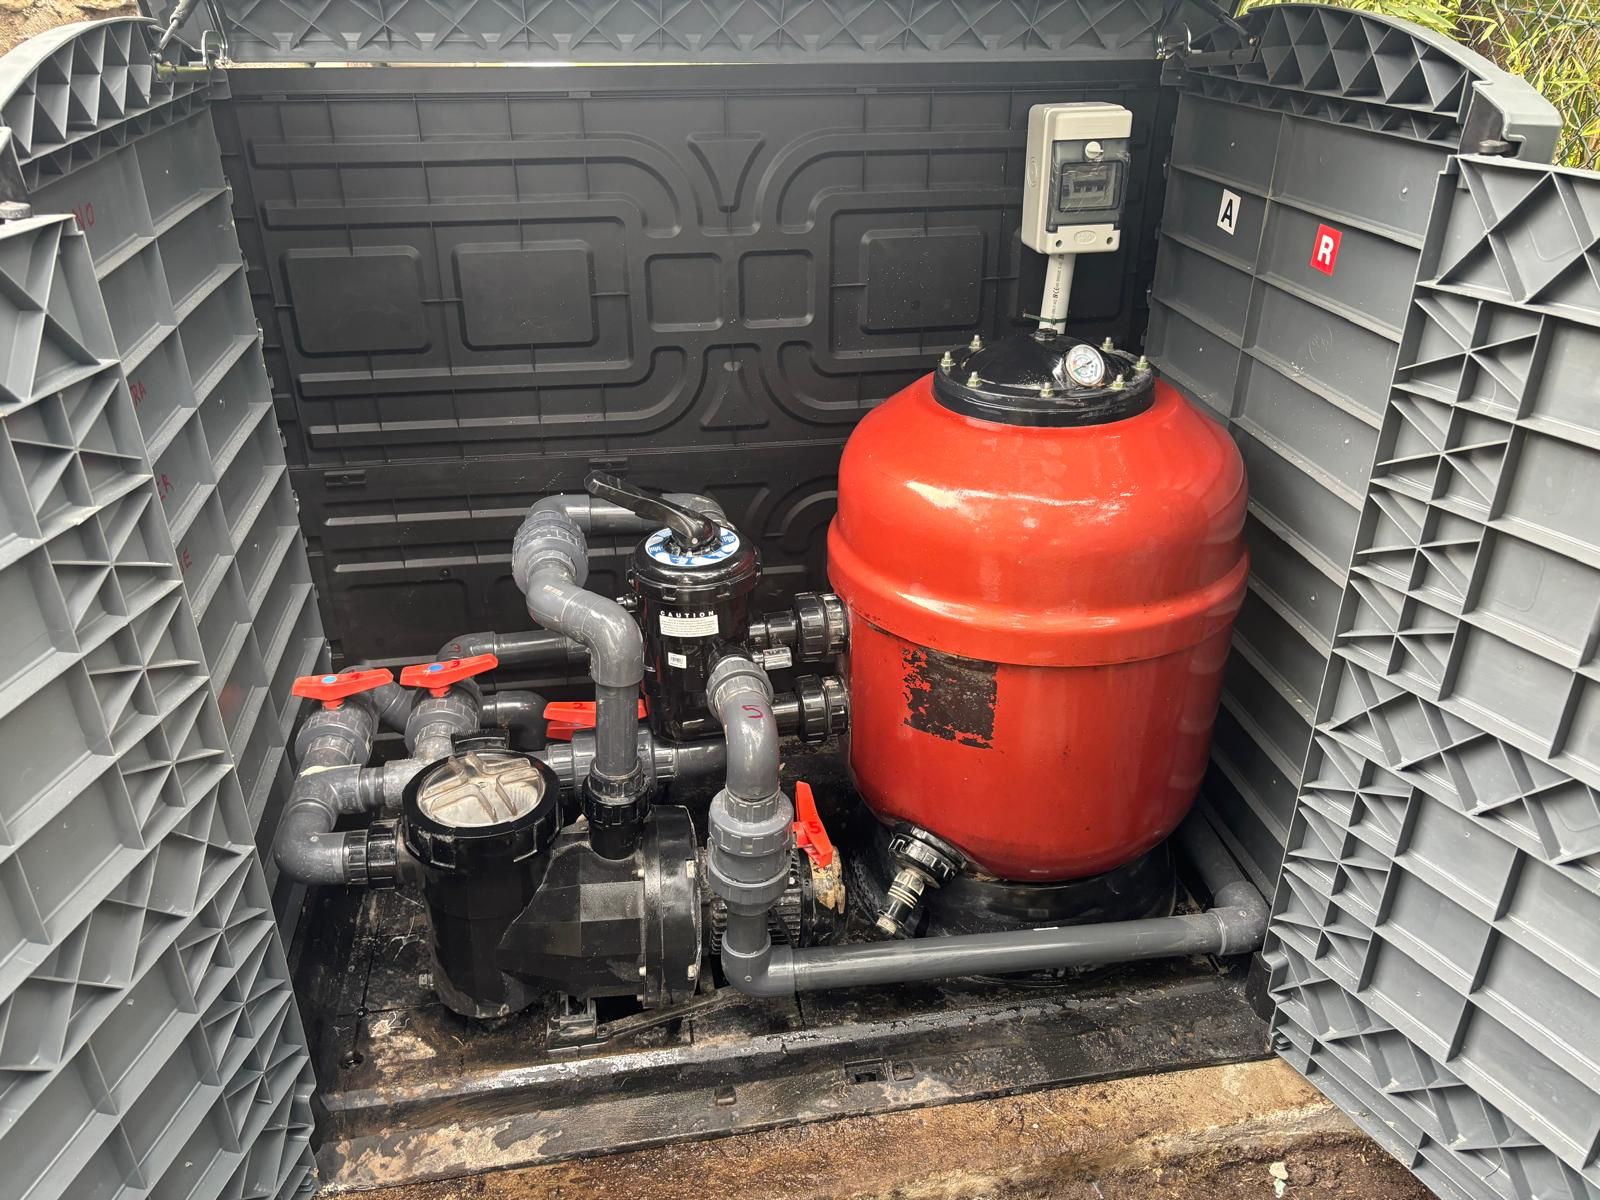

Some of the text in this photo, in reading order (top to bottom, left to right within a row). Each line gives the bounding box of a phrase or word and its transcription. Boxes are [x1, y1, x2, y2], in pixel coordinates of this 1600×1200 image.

[1220, 198, 1233, 228] A
[1317, 233, 1334, 266] R
[660, 610, 715, 619] CAUTION
[573, 702, 587, 710] 2
[808, 821, 822, 834] 5
